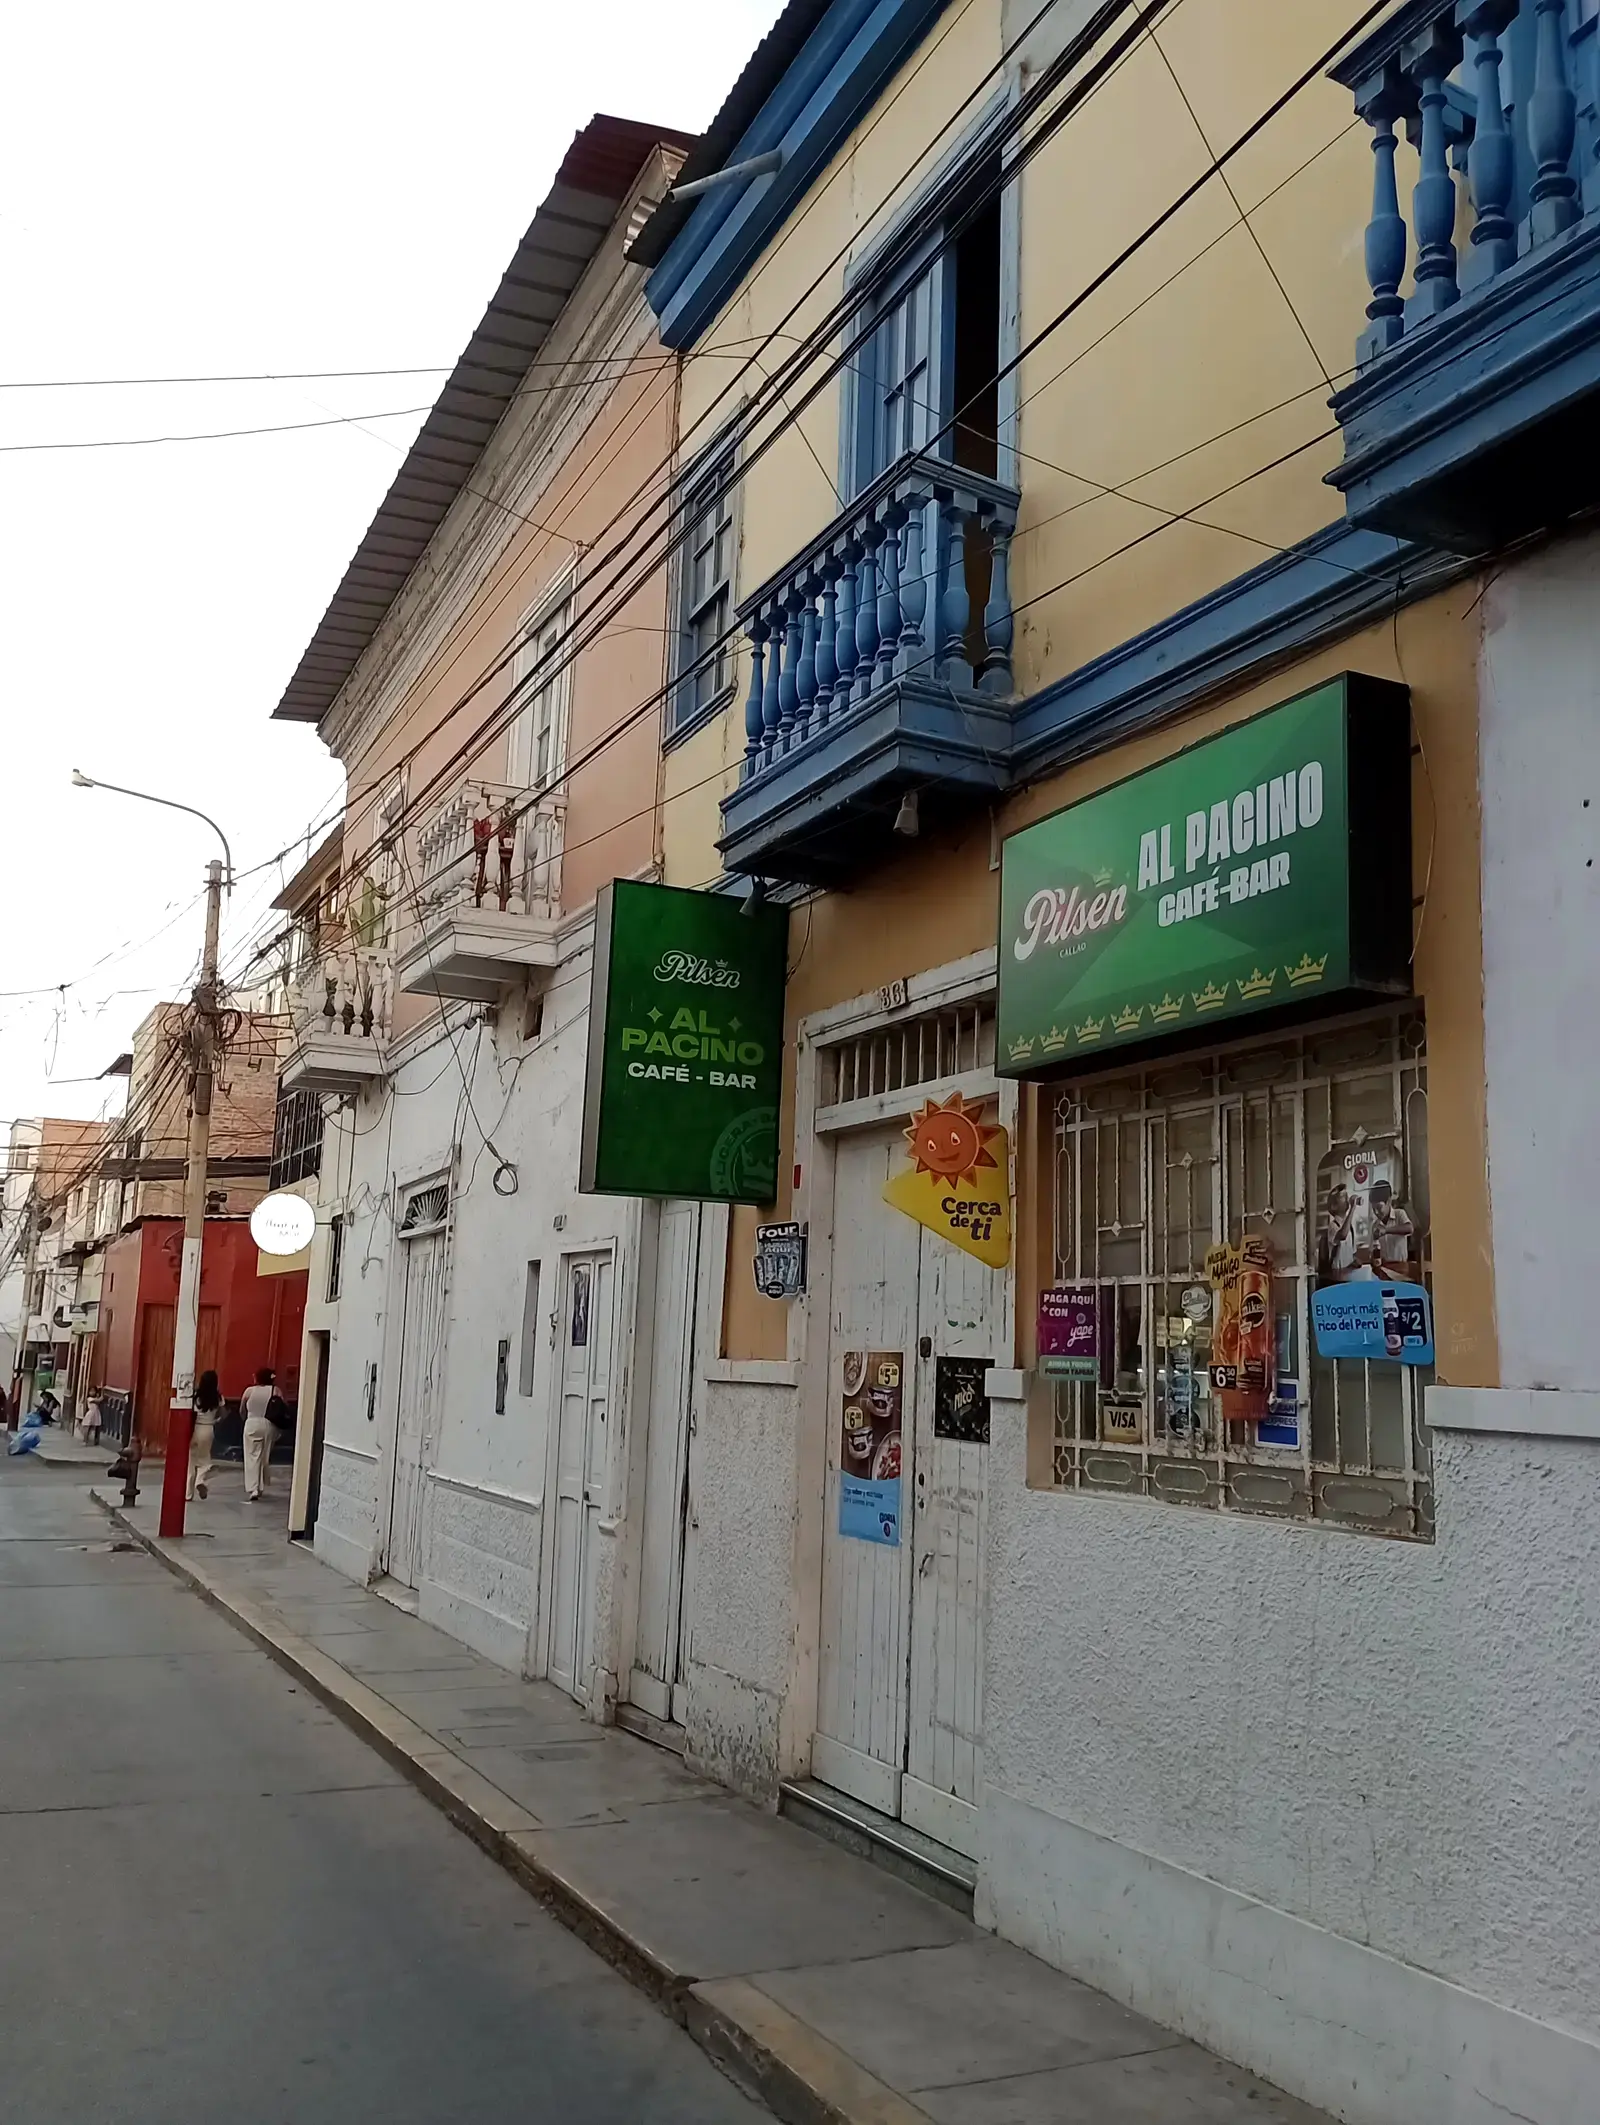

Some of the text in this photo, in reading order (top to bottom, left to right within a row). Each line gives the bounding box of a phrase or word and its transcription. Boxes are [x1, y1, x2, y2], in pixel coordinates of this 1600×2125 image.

[1137, 760, 1325, 892] AL PACINO
[1014, 884, 1127, 961] Pilsen
[1059, 942, 1087, 959] CALLAO
[653, 950, 740, 988] Pilsen
[669, 1007, 720, 1035] AL
[621, 1027, 764, 1066] PACINO
[628, 1062, 690, 1083] CAFÉ
[709, 1071, 756, 1090] BAR
[1344, 1150, 1377, 1169] GLORIA
[941, 1196, 1002, 1216] Cerca
[758, 1225, 797, 1239] four
[950, 1214, 993, 1241] de ti
[1212, 1258, 1240, 1281] MANGO
[1222, 1275, 1239, 1290] HOT
[1043, 1293, 1094, 1306] PAGA AQUÍ
[1315, 1301, 1379, 1318] El Yogurt más
[1048, 1307, 1068, 1317] CON
[1318, 1318, 1379, 1331] rico del Perú
[1067, 1325, 1094, 1347] yape
[1108, 1410, 1136, 1429] VISA
